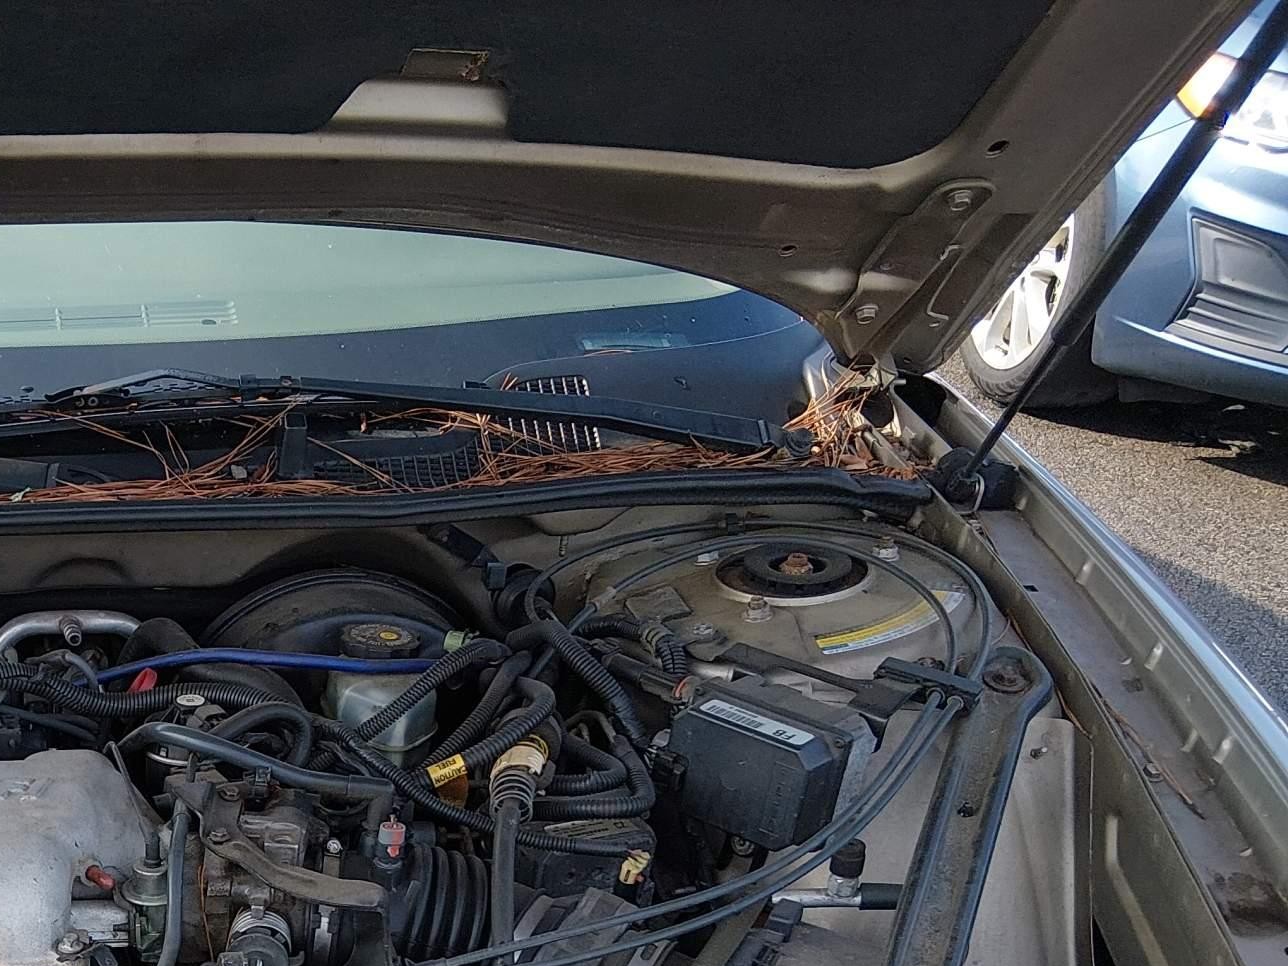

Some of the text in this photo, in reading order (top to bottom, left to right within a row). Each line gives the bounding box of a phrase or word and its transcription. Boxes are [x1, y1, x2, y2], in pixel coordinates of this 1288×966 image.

[773, 727, 797, 741] FB
[436, 759, 456, 770] FUEL
[433, 766, 466, 784] CAUTION
